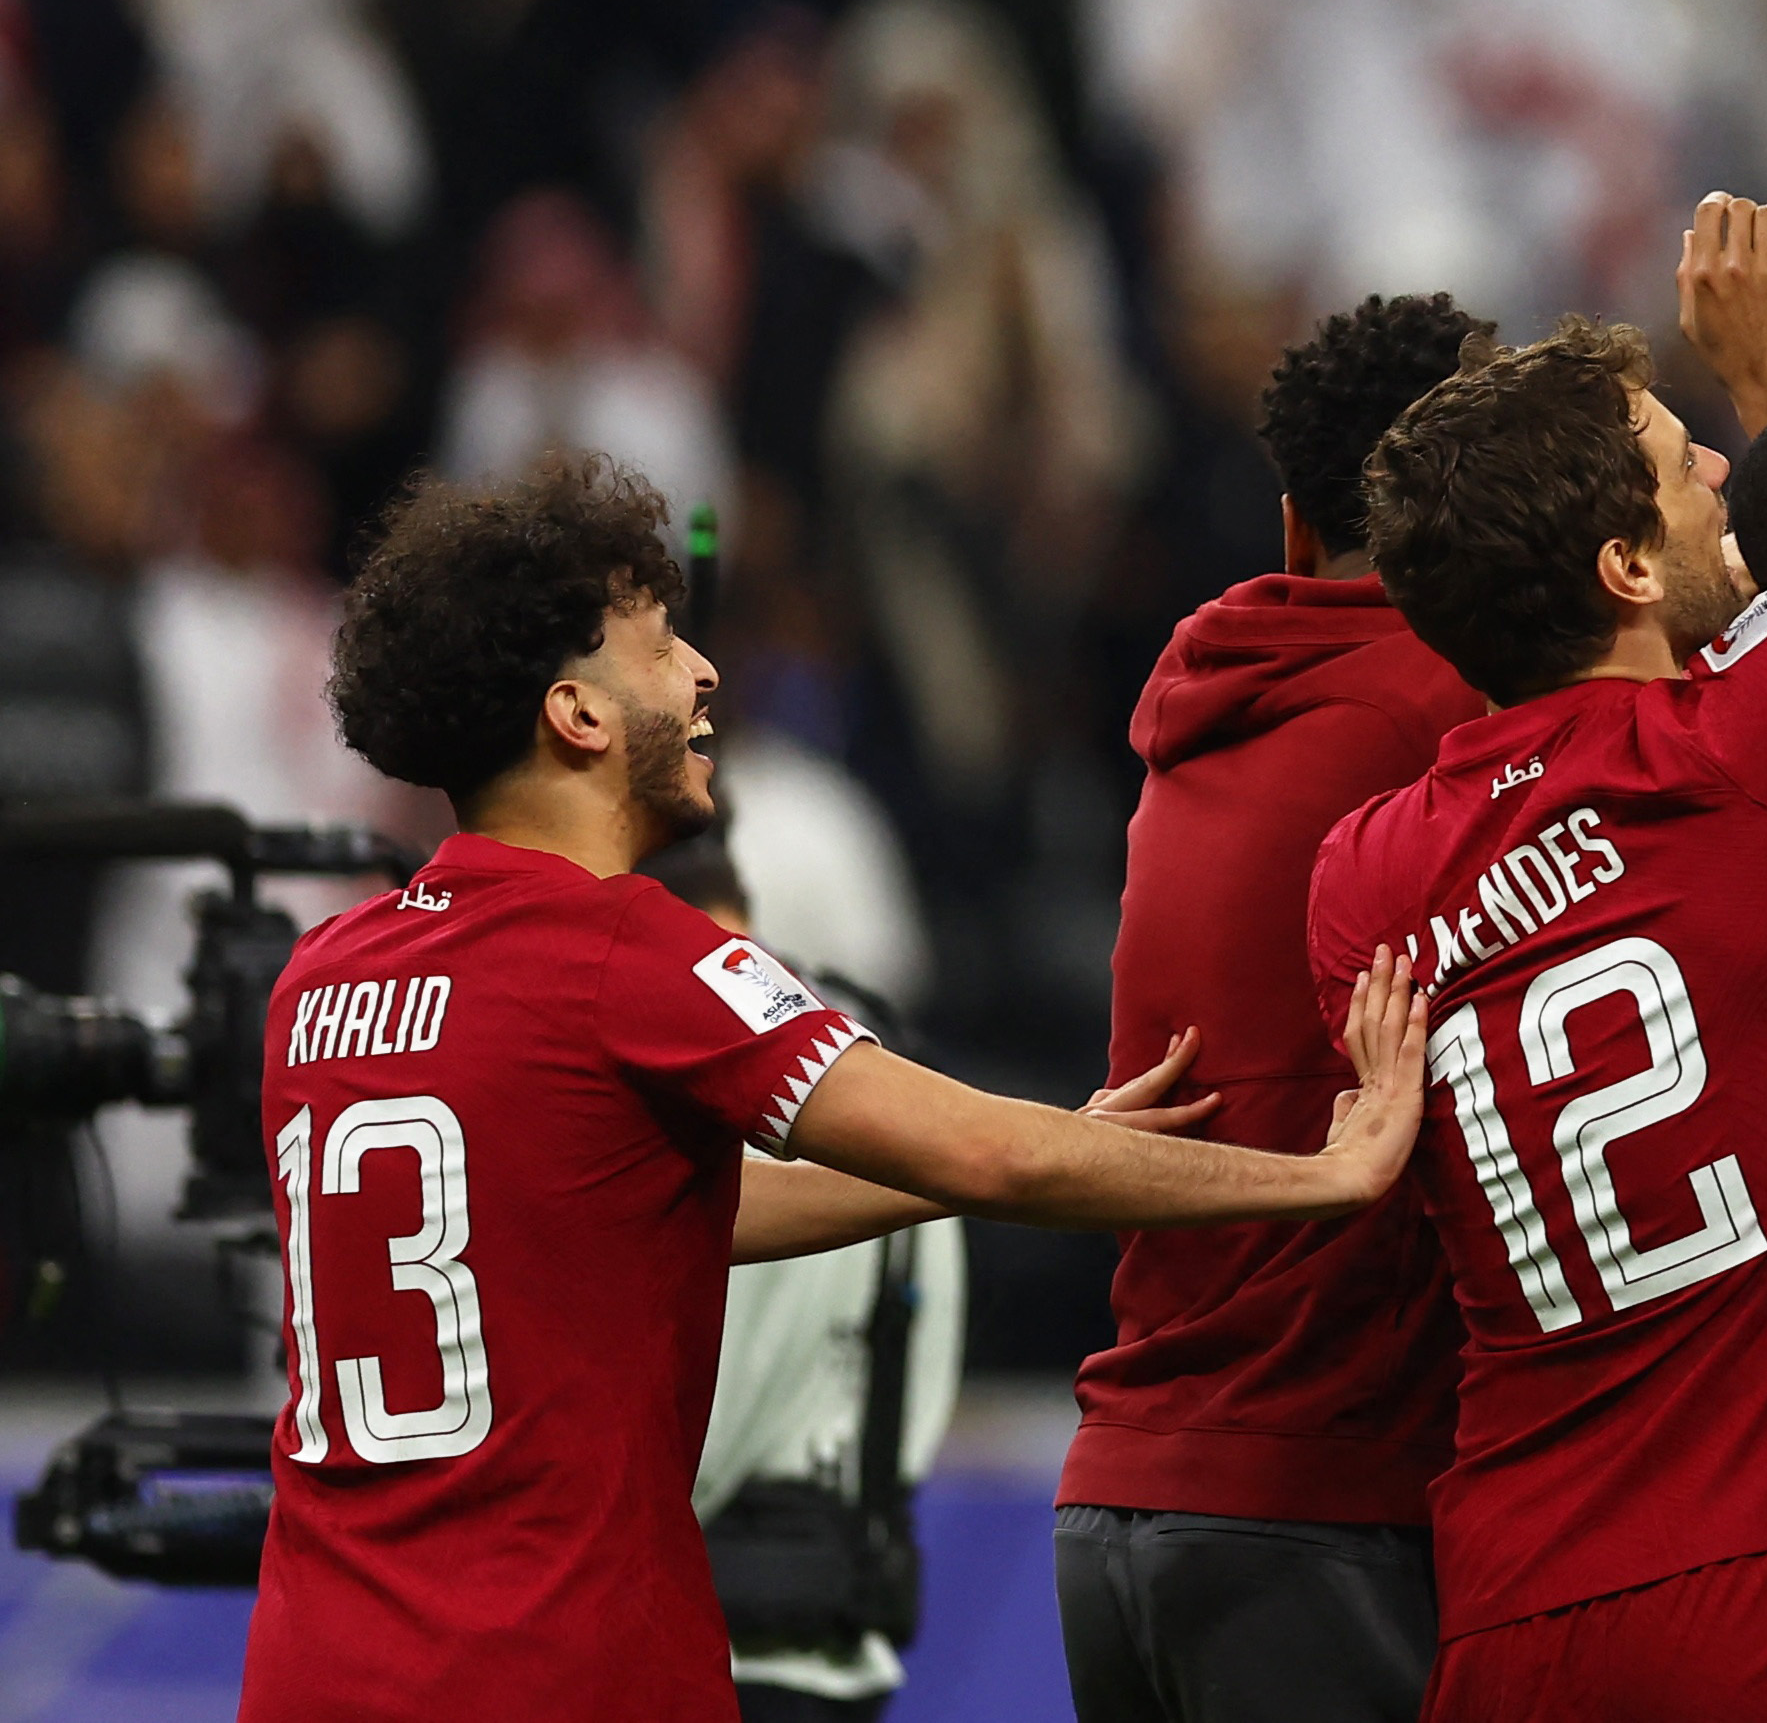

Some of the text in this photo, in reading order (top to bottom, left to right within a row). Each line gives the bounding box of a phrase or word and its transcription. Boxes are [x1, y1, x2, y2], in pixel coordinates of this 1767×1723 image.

[1491, 756, 1544, 799] قطر
[397, 882, 452, 911] قطر
[1406, 807, 1626, 999] .MENDES
[287, 976, 452, 1067] KHALID
[276, 1095, 493, 1465] 13
